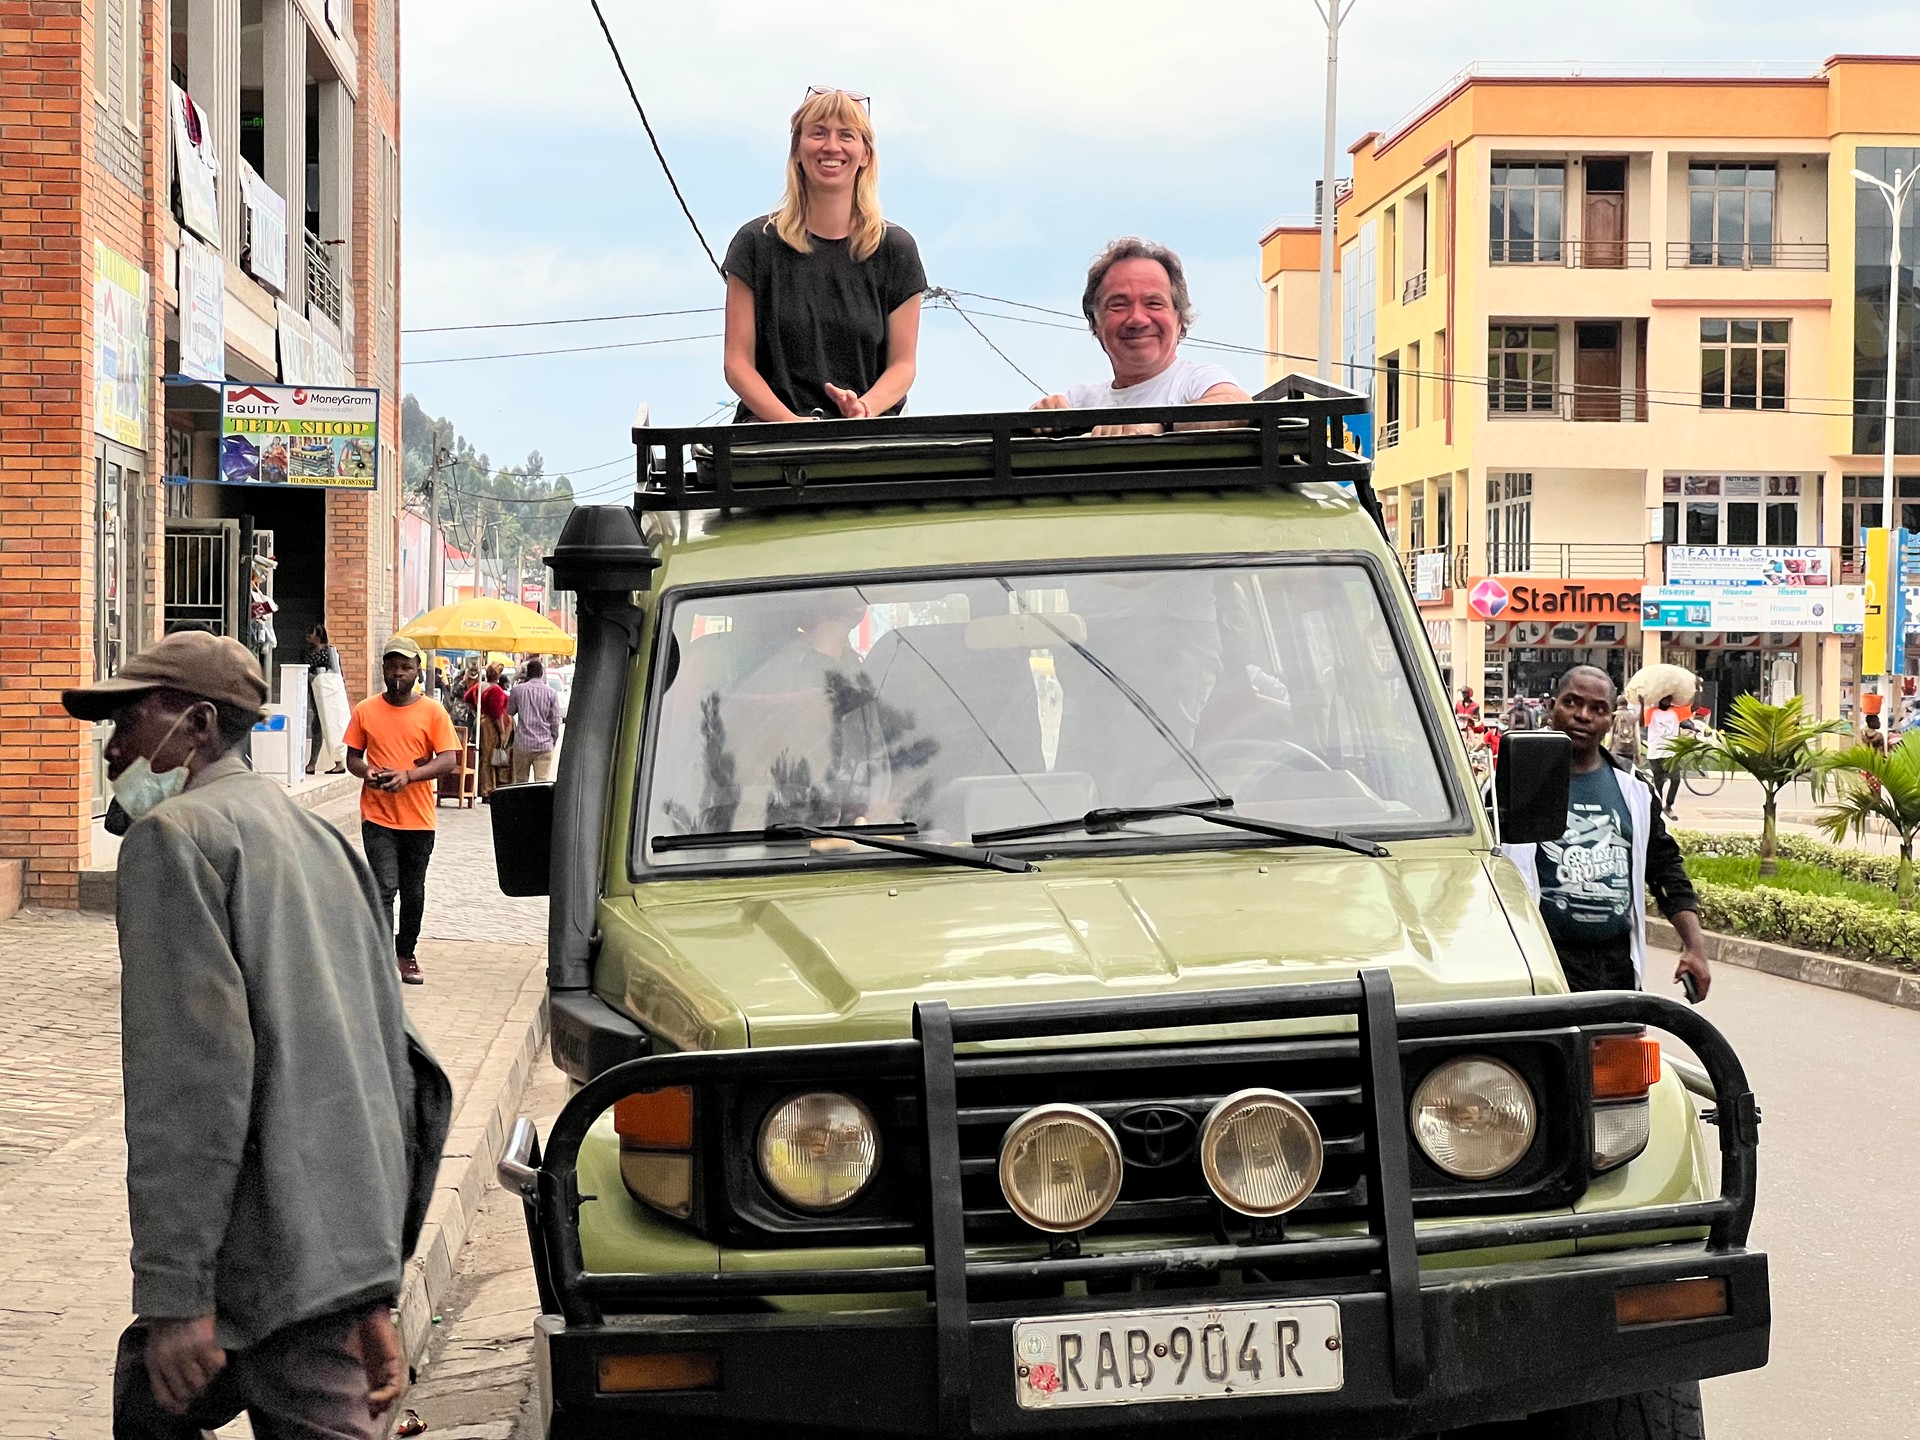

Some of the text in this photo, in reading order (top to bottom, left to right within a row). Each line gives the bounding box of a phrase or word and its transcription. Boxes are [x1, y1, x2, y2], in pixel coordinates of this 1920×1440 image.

[310, 393, 372, 406] MoneyGram
[227, 404, 280, 415] EQUITY
[230, 418, 370, 435] TETA SHOP
[1688, 547, 1817, 558] FAITH CLINIC
[1659, 587, 1807, 596] Hisense Hisense Hisense
[1770, 604, 1801, 612] Hisense
[1058, 1319, 1304, 1391] RAB 904 R
